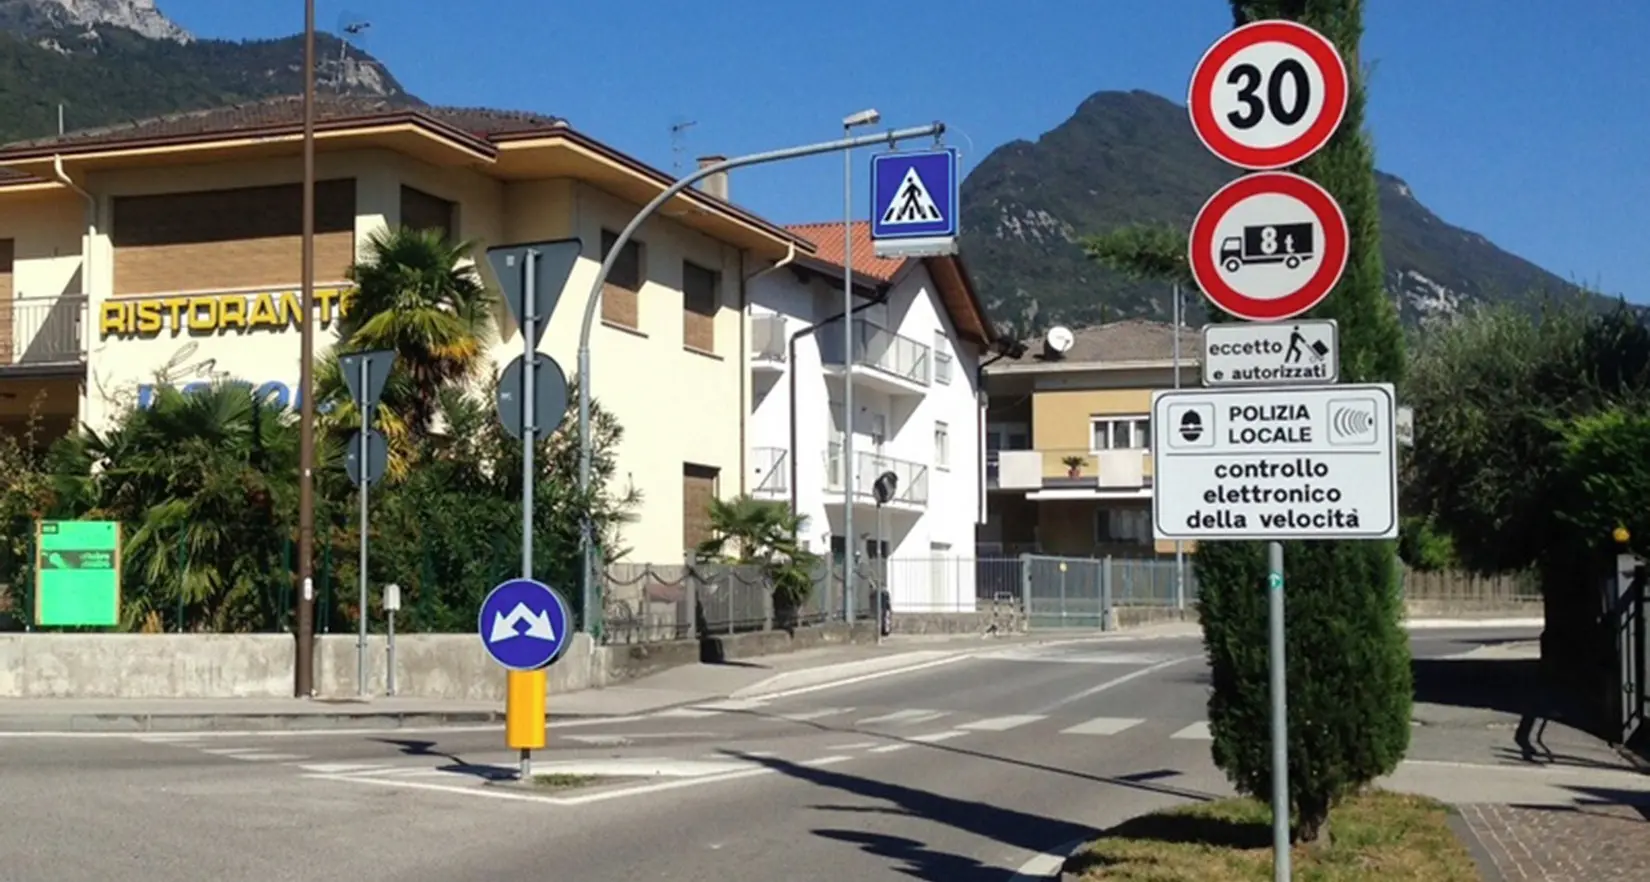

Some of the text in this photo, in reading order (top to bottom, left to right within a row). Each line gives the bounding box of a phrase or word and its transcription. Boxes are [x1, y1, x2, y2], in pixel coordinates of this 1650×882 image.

[1226, 57, 1312, 130] 30
[1259, 226, 1296, 256] 8 t
[1208, 339, 1284, 357] eccetto
[1212, 363, 1327, 381] e autorizzati
[1228, 404, 1311, 422] POLIZIA
[1228, 426, 1313, 444] LOCALE
[1214, 458, 1329, 479] controllo
[1203, 484, 1342, 504] elettronico
[1186, 508, 1361, 529] della velocità
